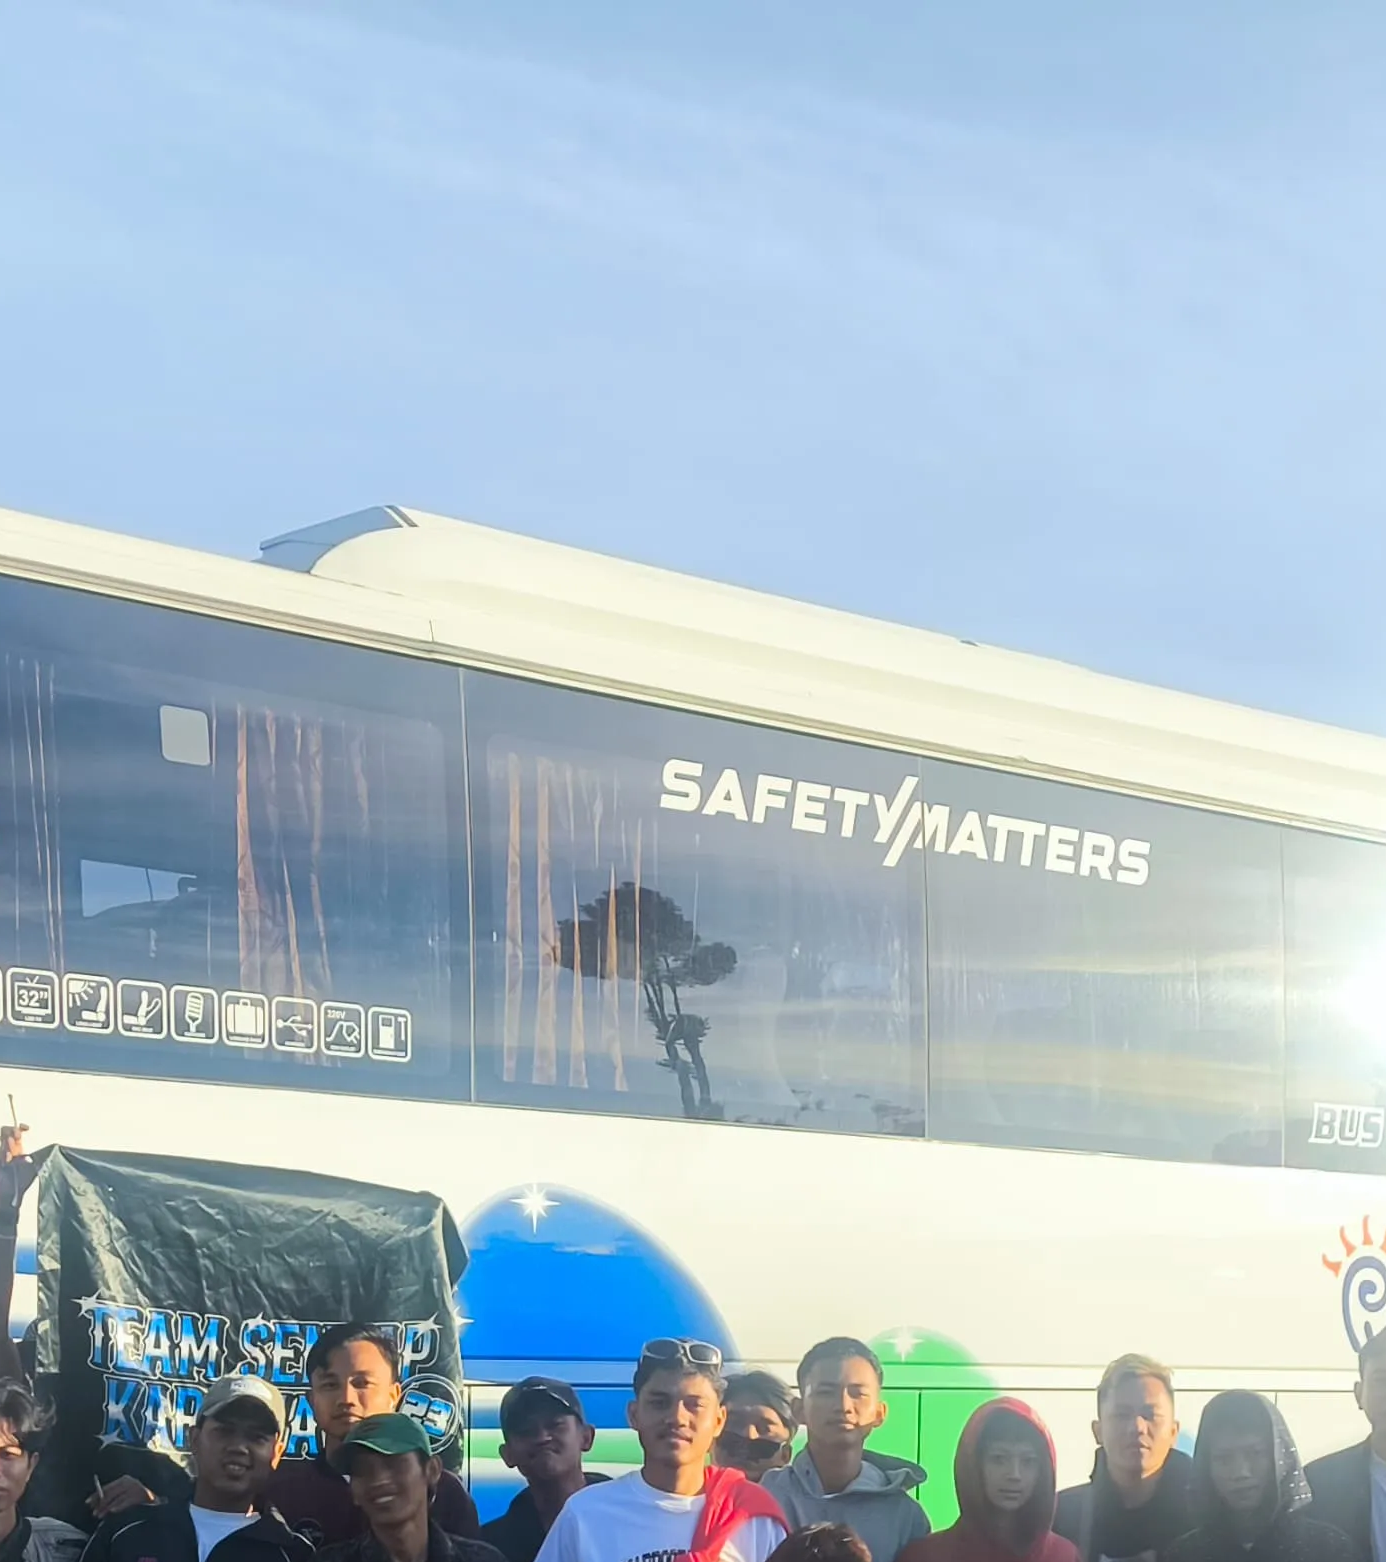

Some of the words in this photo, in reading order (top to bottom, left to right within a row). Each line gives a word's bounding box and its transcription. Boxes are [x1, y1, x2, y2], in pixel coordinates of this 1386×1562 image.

[1310, 1102, 1384, 1147] BUS
[90, 1302, 226, 1381] TEAM
[400, 1390, 454, 1438] 23
